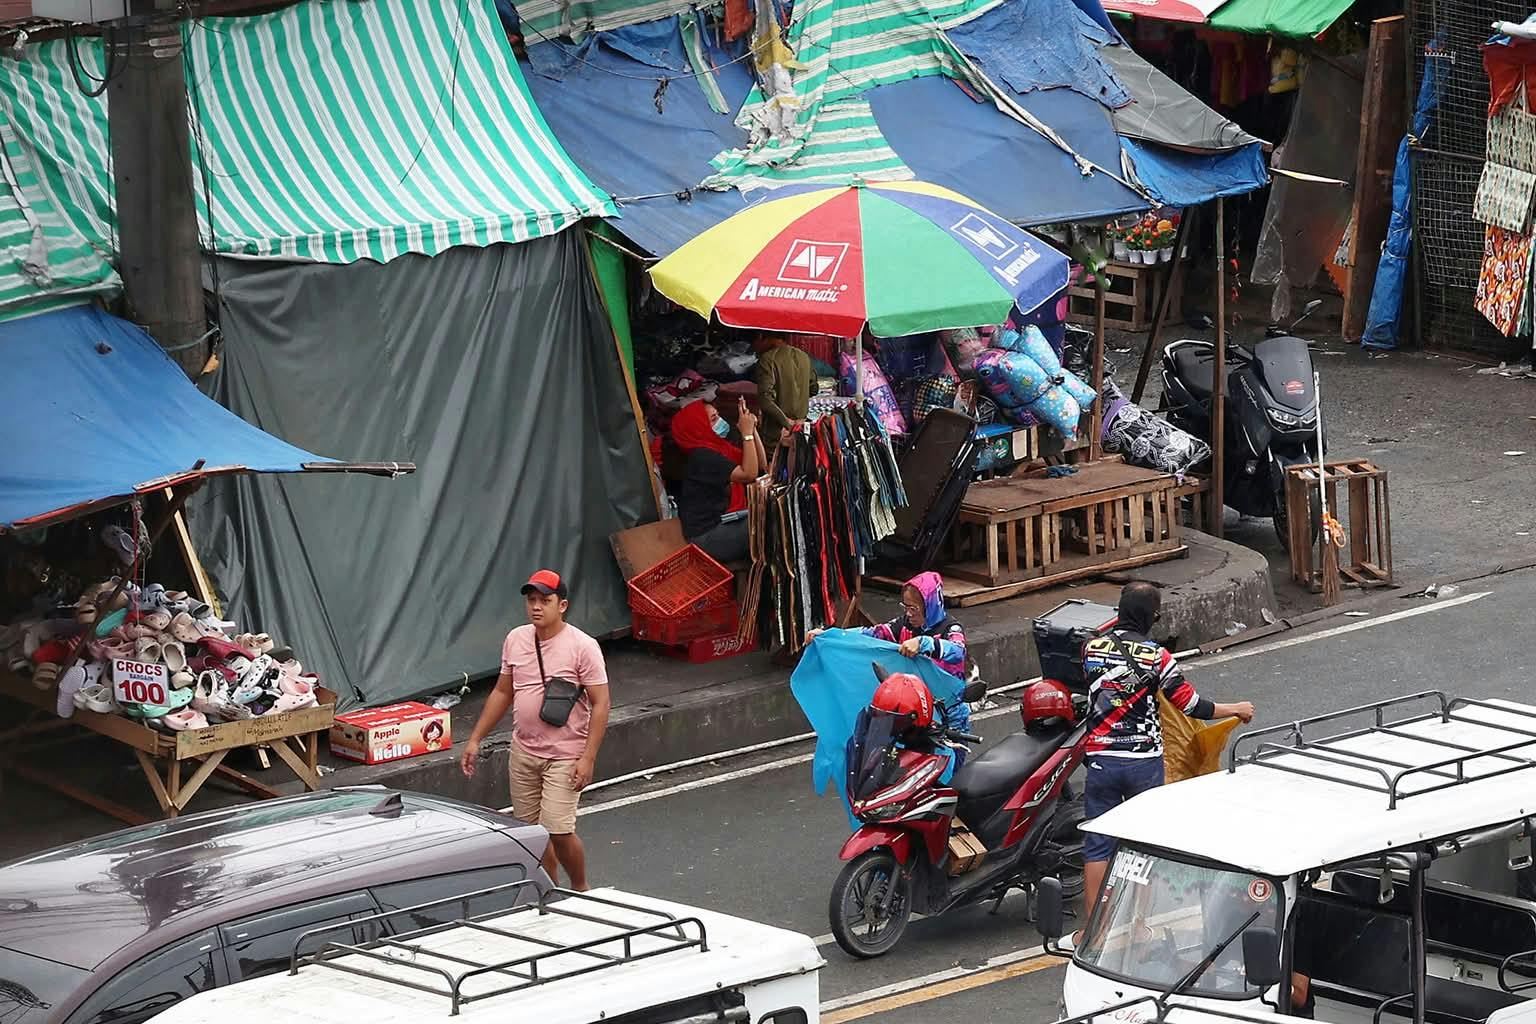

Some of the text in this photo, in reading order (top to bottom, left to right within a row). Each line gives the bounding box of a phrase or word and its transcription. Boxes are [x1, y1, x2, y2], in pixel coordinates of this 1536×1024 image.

[116, 660, 162, 676] CROCS
[118, 679, 165, 705] 100
[373, 728, 400, 740] Apple
[373, 743, 412, 762] Hello
[1033, 753, 1073, 801] CLICK
